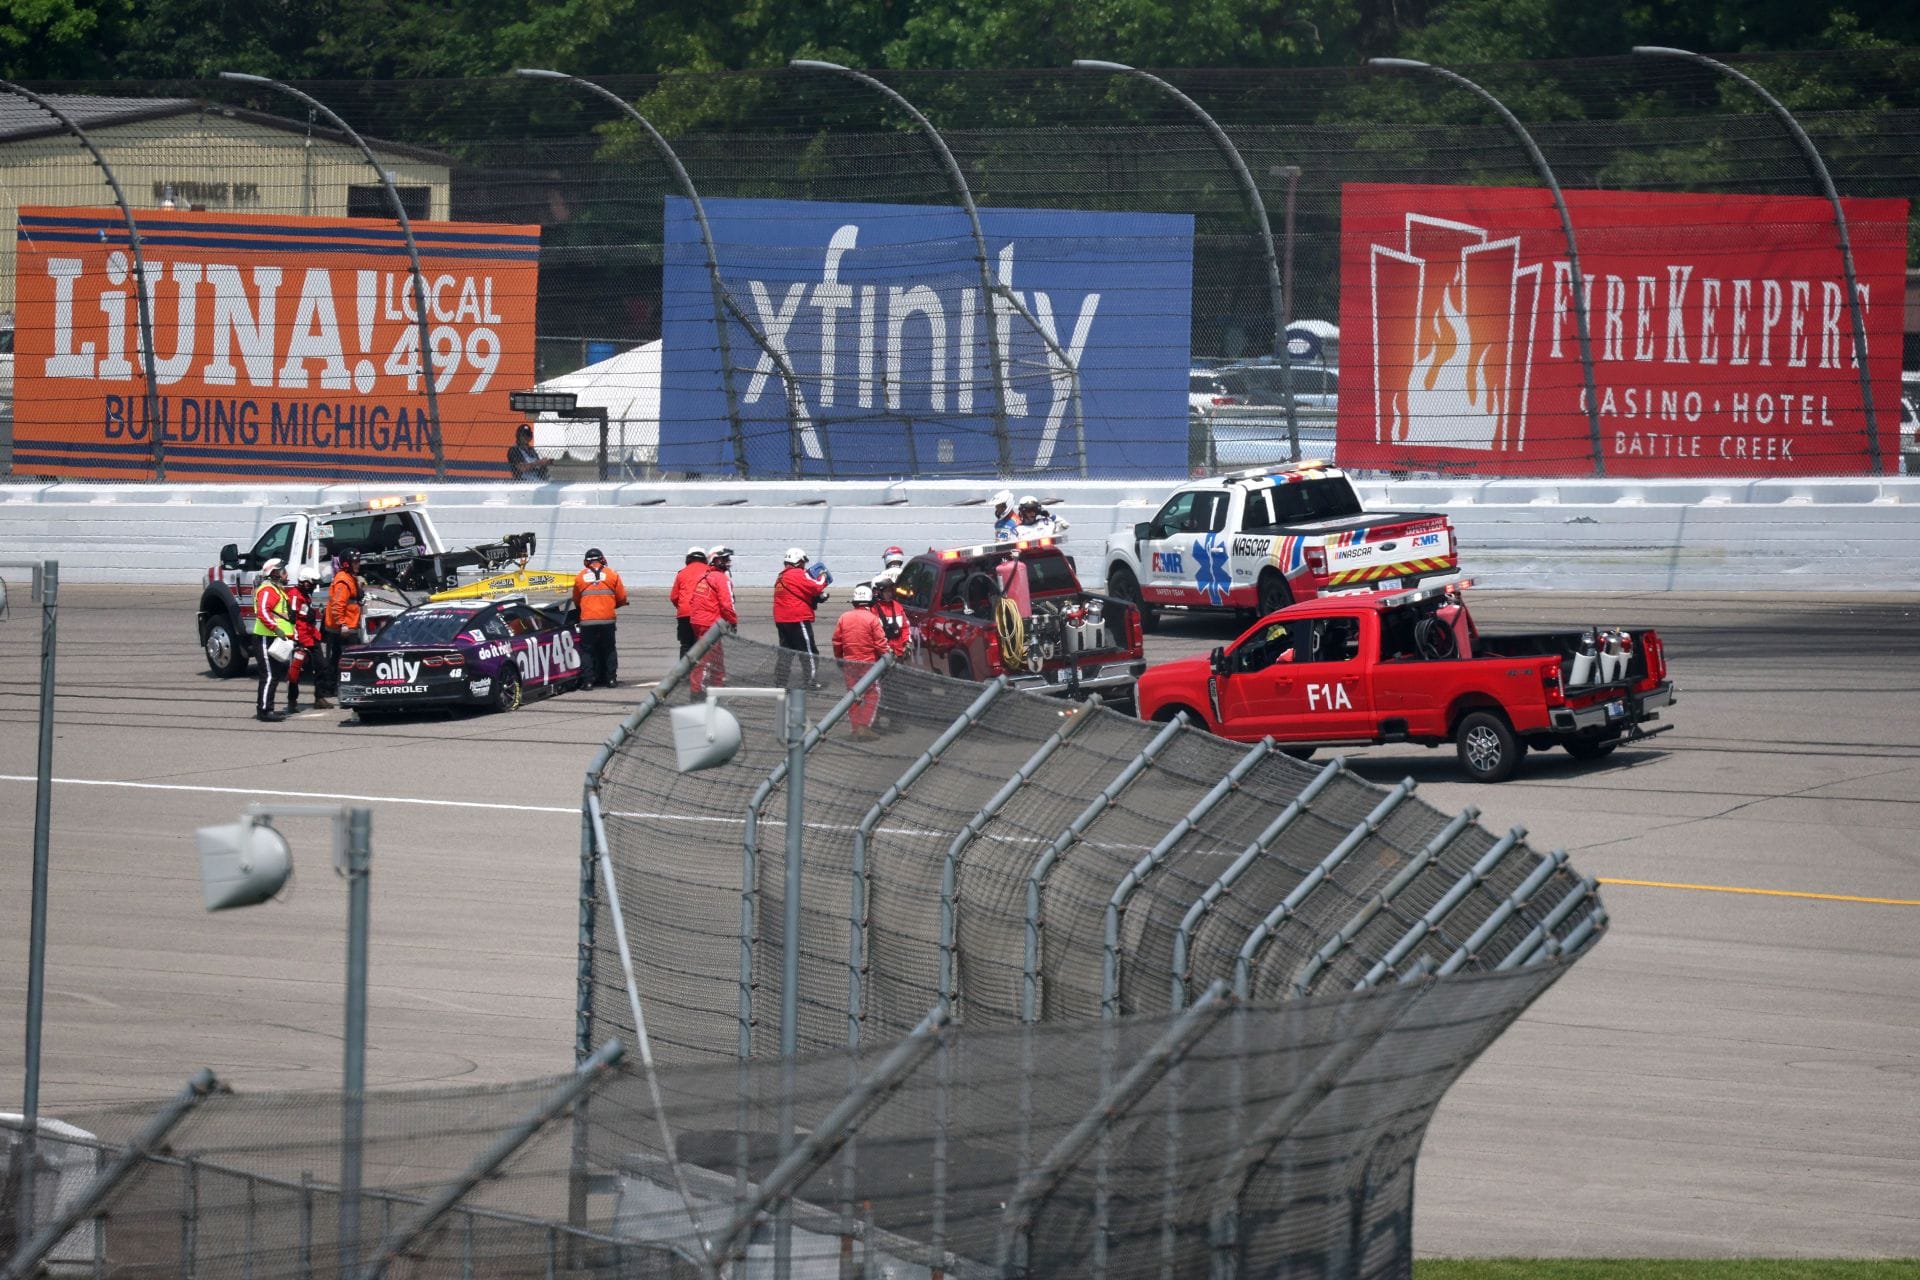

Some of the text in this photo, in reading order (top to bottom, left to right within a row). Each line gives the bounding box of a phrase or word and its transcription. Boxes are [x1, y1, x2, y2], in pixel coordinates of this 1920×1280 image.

[384, 272, 501, 324] LOCAL
[45, 251, 377, 394] LiUNA!
[384, 325, 501, 394] 499
[743, 225, 1100, 468] xfinity
[105, 395, 436, 453] BULDING MICHIGAN
[1732, 393, 1834, 427] HOTEL
[1615, 431, 1794, 462] BATTLE CREEK
[1232, 538, 1271, 557] NASCAR
[1341, 547, 1372, 560] NASCAR
[1152, 552, 1184, 574] AMR
[479, 647, 492, 660] do
[516, 630, 581, 686] ally 48
[376, 657, 421, 684] ally
[449, 668, 463, 679] 48
[365, 685, 429, 695] CHEVROLET
[1306, 682, 1353, 711] F1A
